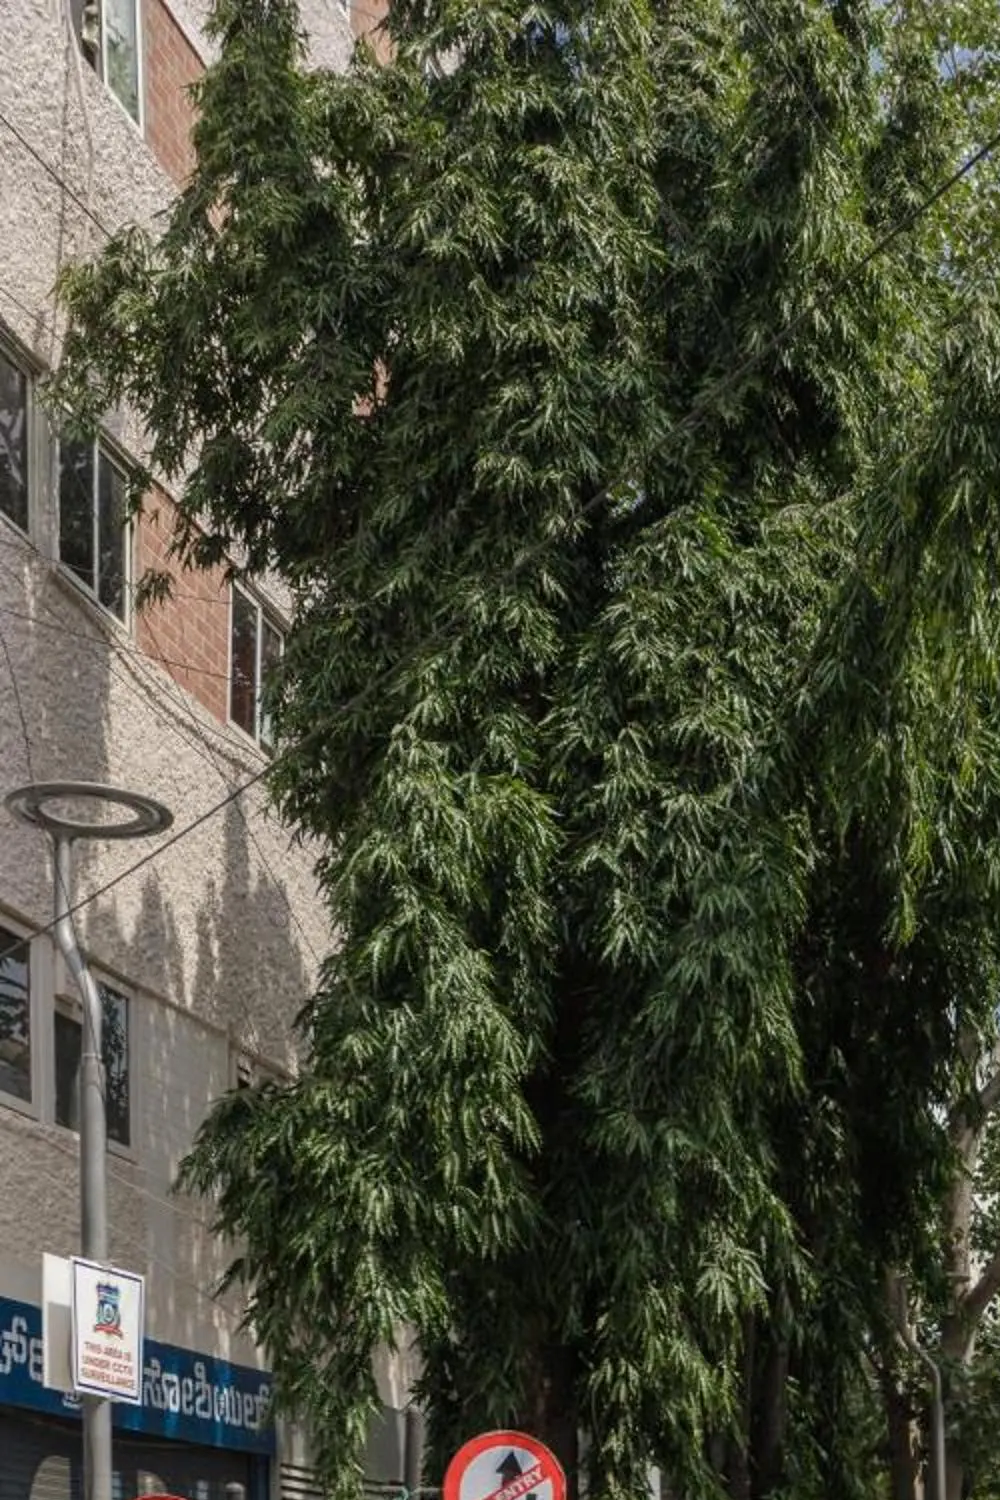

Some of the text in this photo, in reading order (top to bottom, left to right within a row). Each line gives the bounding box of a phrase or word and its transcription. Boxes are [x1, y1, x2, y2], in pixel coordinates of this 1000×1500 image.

[84, 1341, 101, 1354] THIS
[103, 1346, 122, 1359] AREA
[82, 1355, 110, 1369] UNDER
[81, 1367, 135, 1389] SURVEILLANCE
